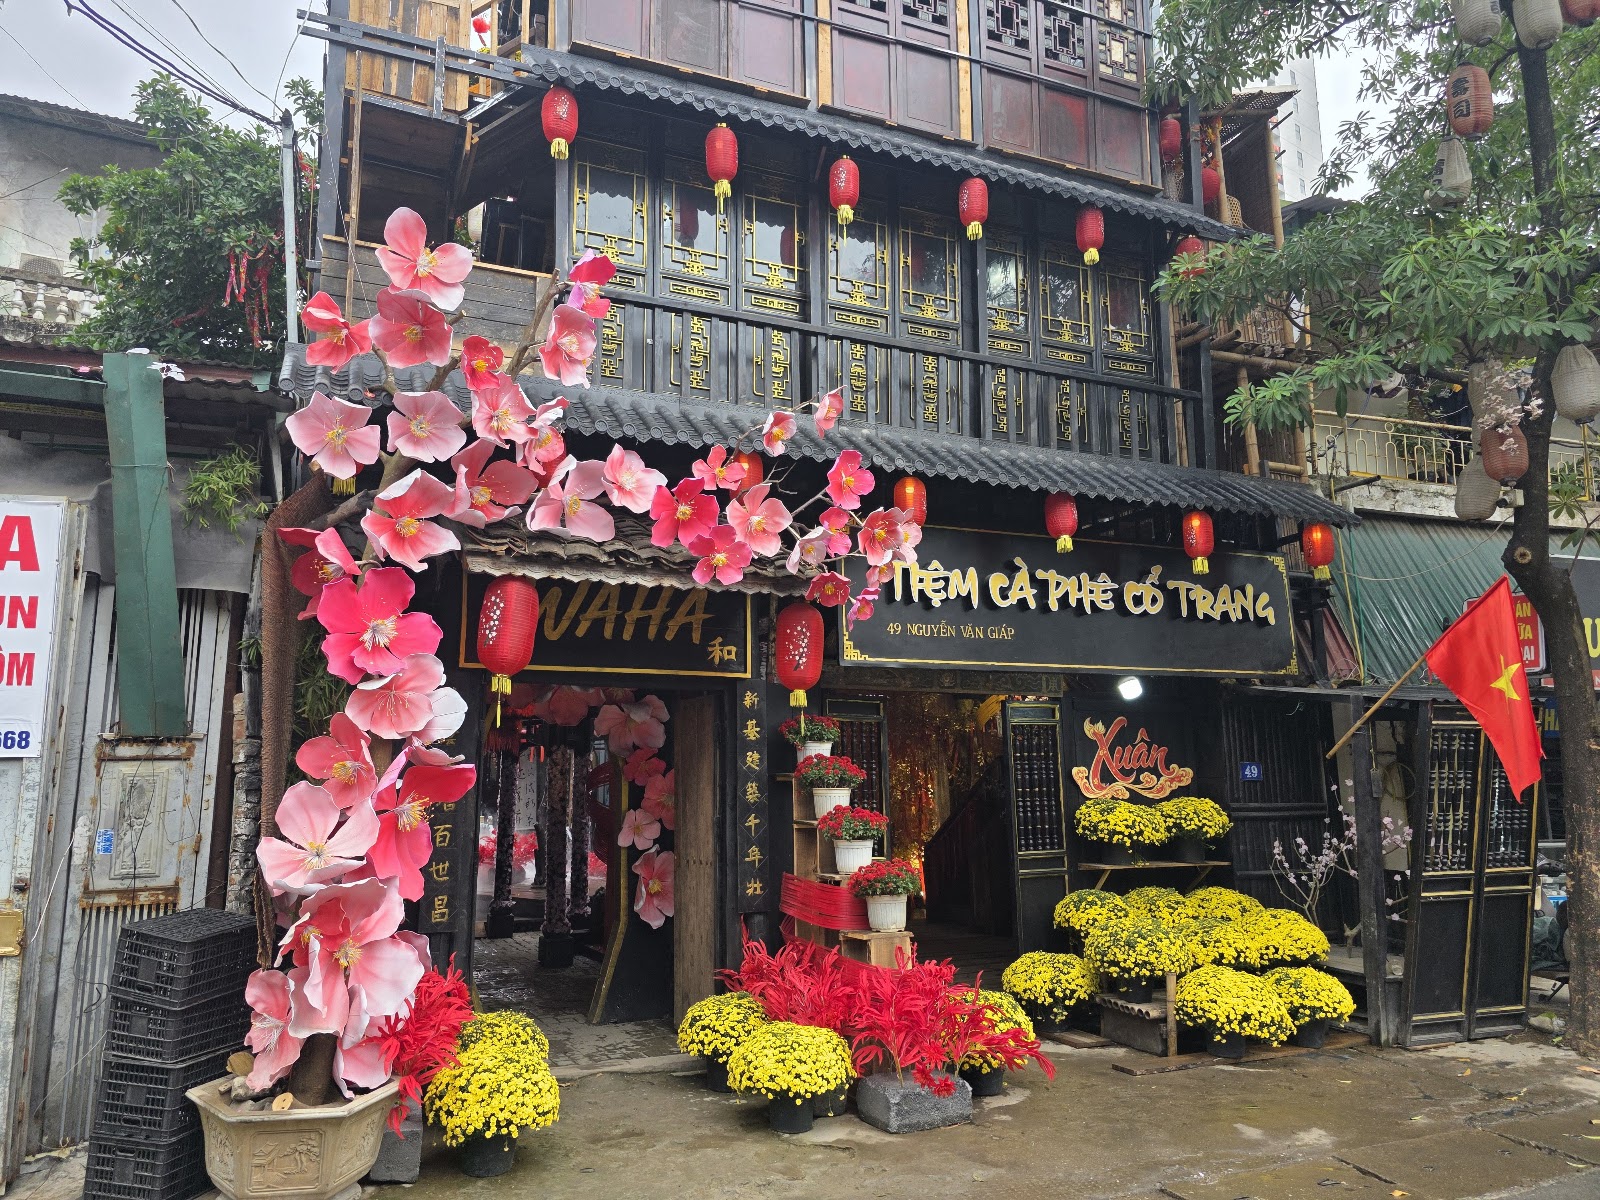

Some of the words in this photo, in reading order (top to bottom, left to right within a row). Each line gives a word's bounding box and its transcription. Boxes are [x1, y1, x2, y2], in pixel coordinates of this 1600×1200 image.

[893, 560, 979, 608] TIỆM
[988, 557, 1037, 610] CÀ
[1035, 569, 1119, 615] PHÊ
[1124, 565, 1164, 615] CỔ
[1166, 580, 1276, 626] TRANG
[1515, 600, 1532, 618] ÁN
[887, 622, 902, 635] 49
[906, 620, 956, 638] NGUYỄN
[960, 623, 984, 639] VĂN
[988, 624, 1015, 640] GIÁP
[707, 636, 737, 668] 和
[1521, 646, 1535, 664] ẠI
[0, 646, 36, 686] M
[0, 730, 31, 749] 68
[1084, 716, 1178, 792] Xuân
[1244, 764, 1258, 778] 49
